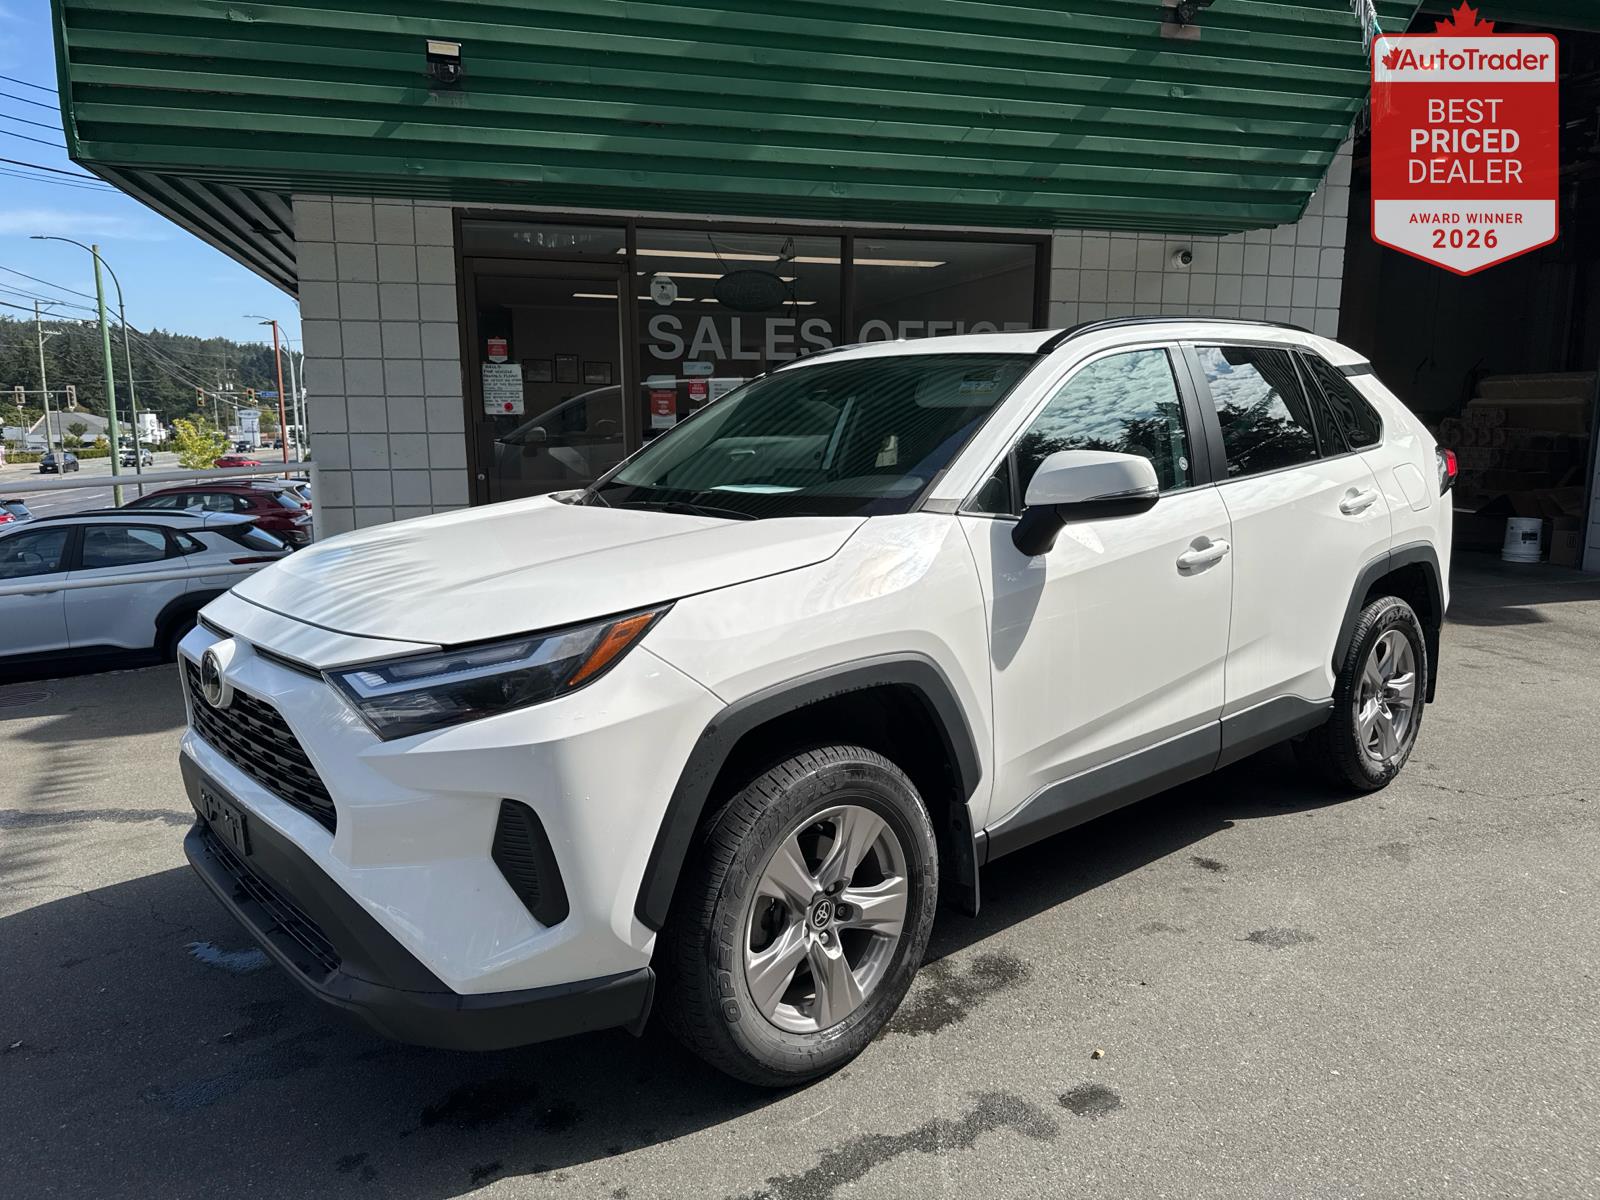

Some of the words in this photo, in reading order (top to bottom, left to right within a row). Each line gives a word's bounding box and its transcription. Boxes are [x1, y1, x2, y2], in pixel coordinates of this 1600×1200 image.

[648, 314, 833, 361] SALES
[858, 319, 1029, 343] OFF
[718, 913, 741, 1023] OPEN
